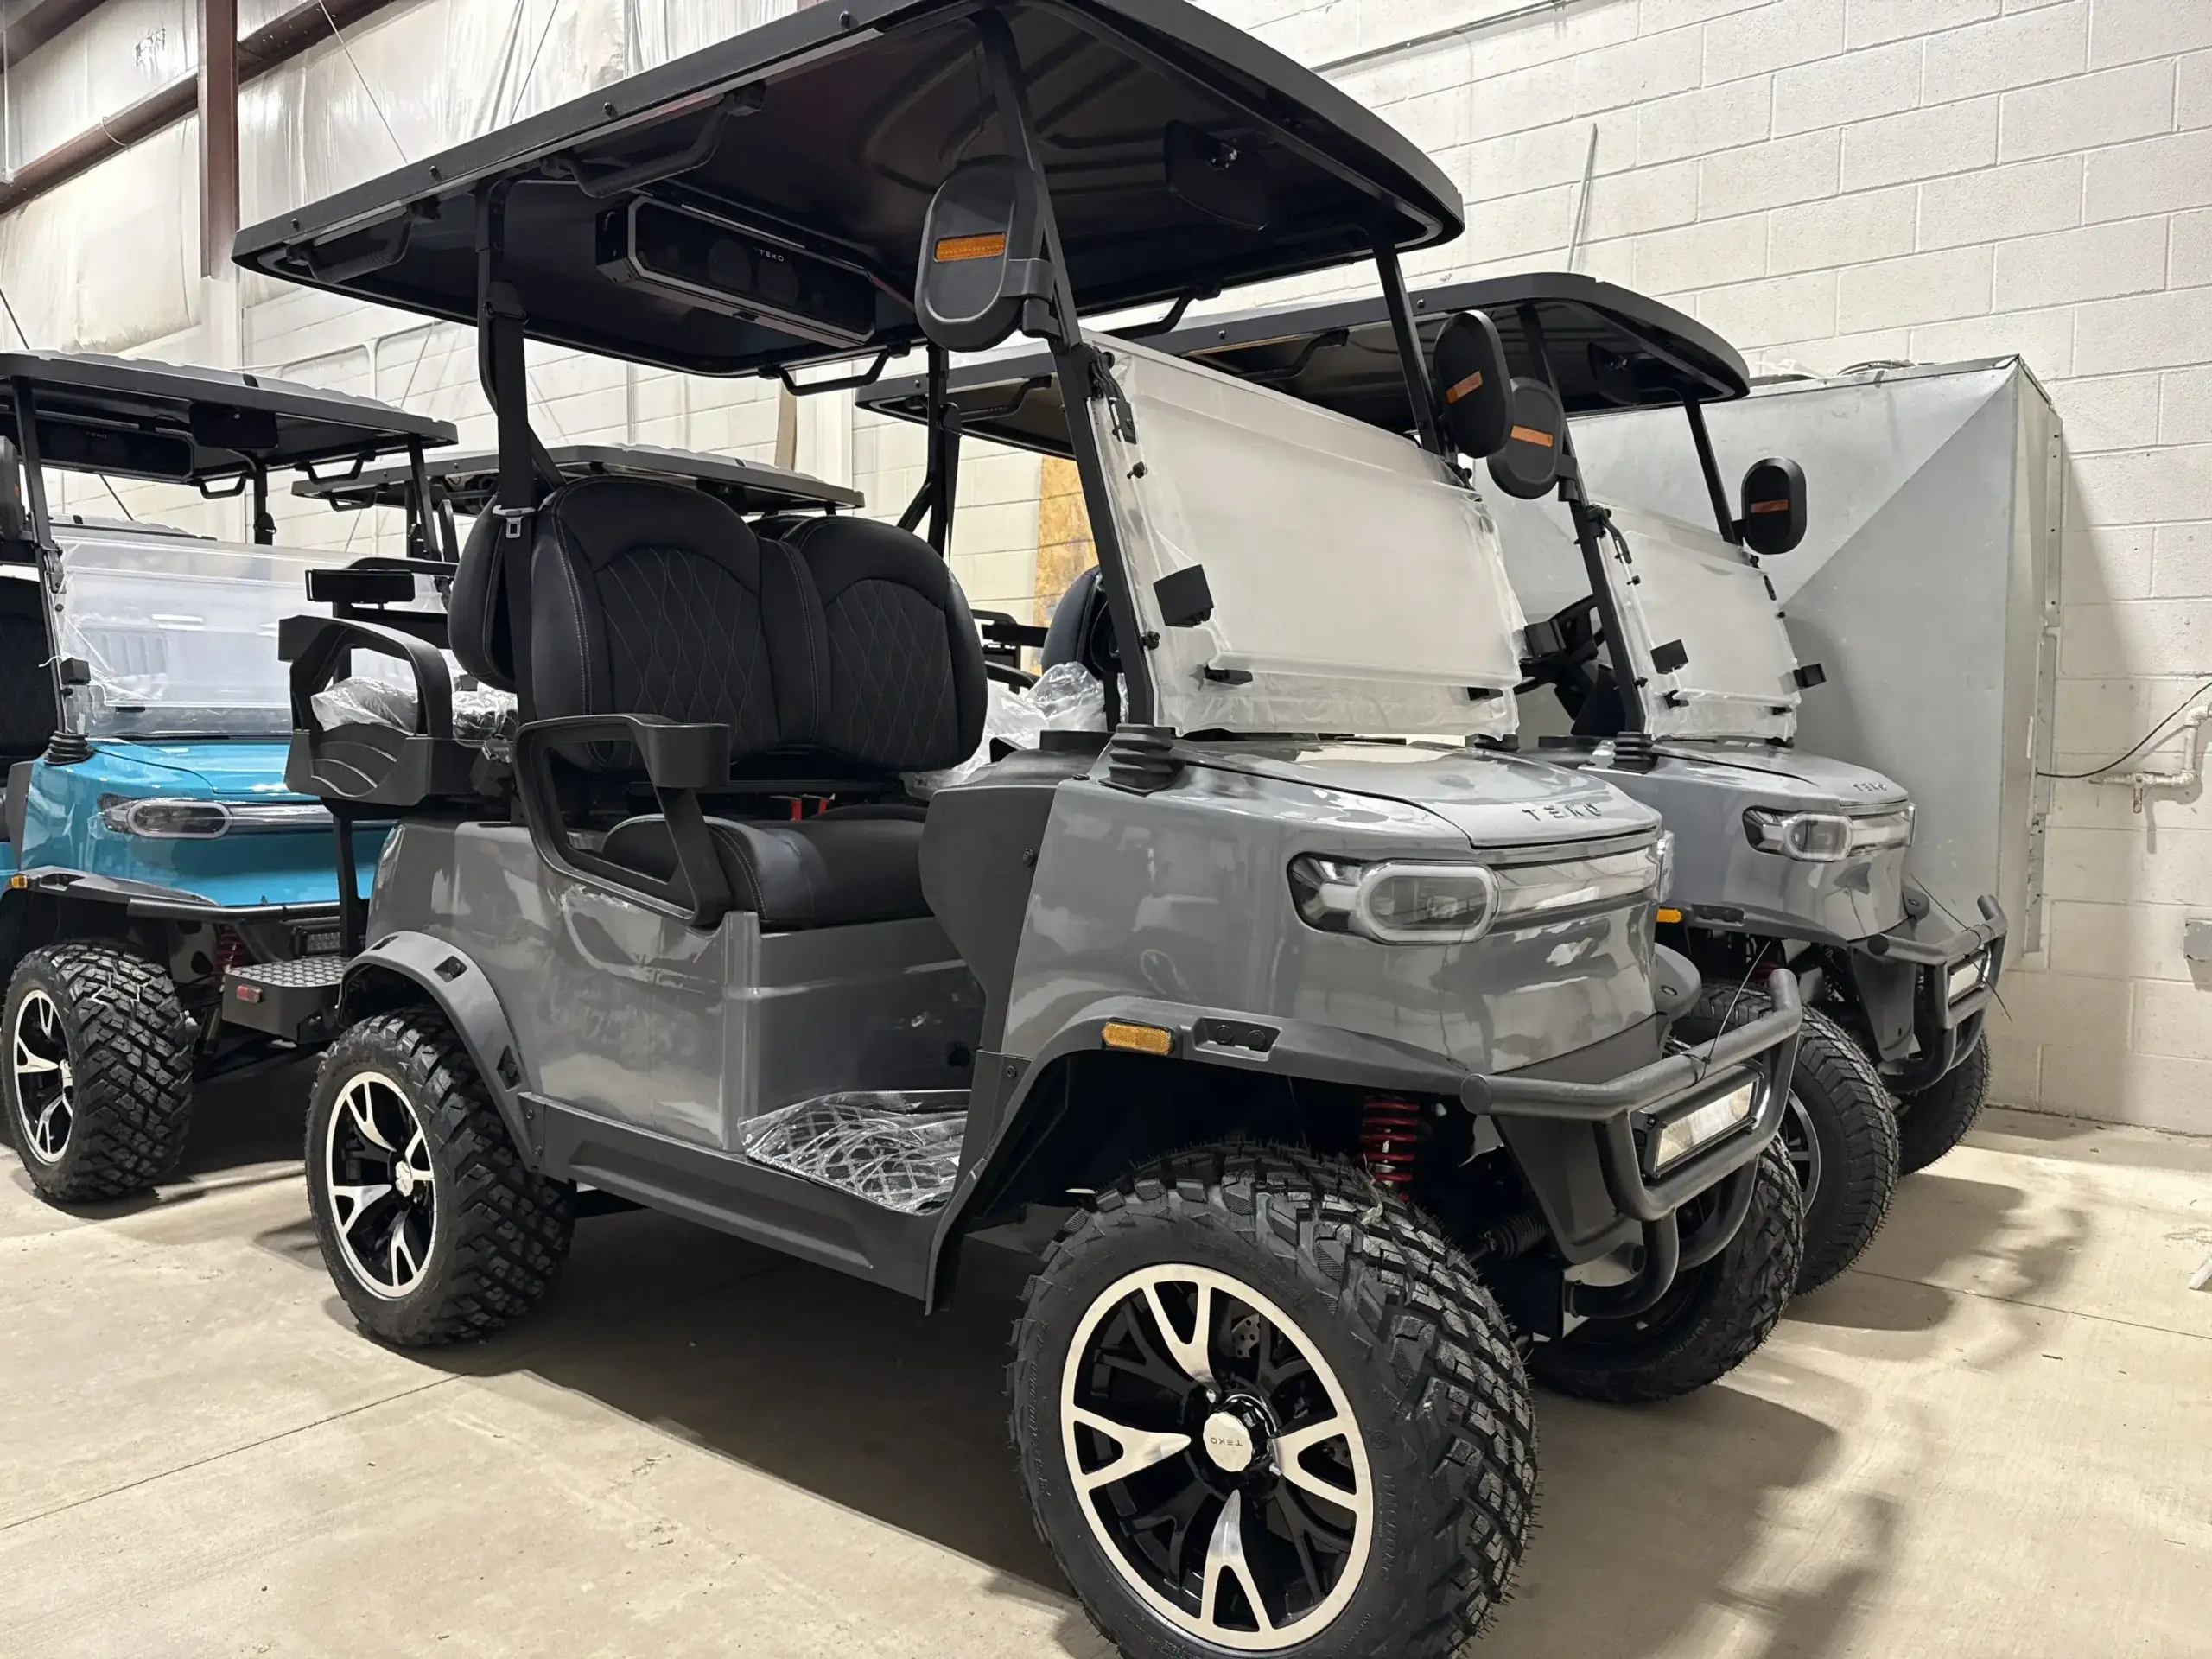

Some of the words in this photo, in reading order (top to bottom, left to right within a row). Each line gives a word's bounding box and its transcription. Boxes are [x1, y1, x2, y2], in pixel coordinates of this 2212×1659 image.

[759, 249, 785, 262] TEKO
[1521, 802, 1602, 823] TEKO
[1210, 1437, 1243, 1447] TEKO
